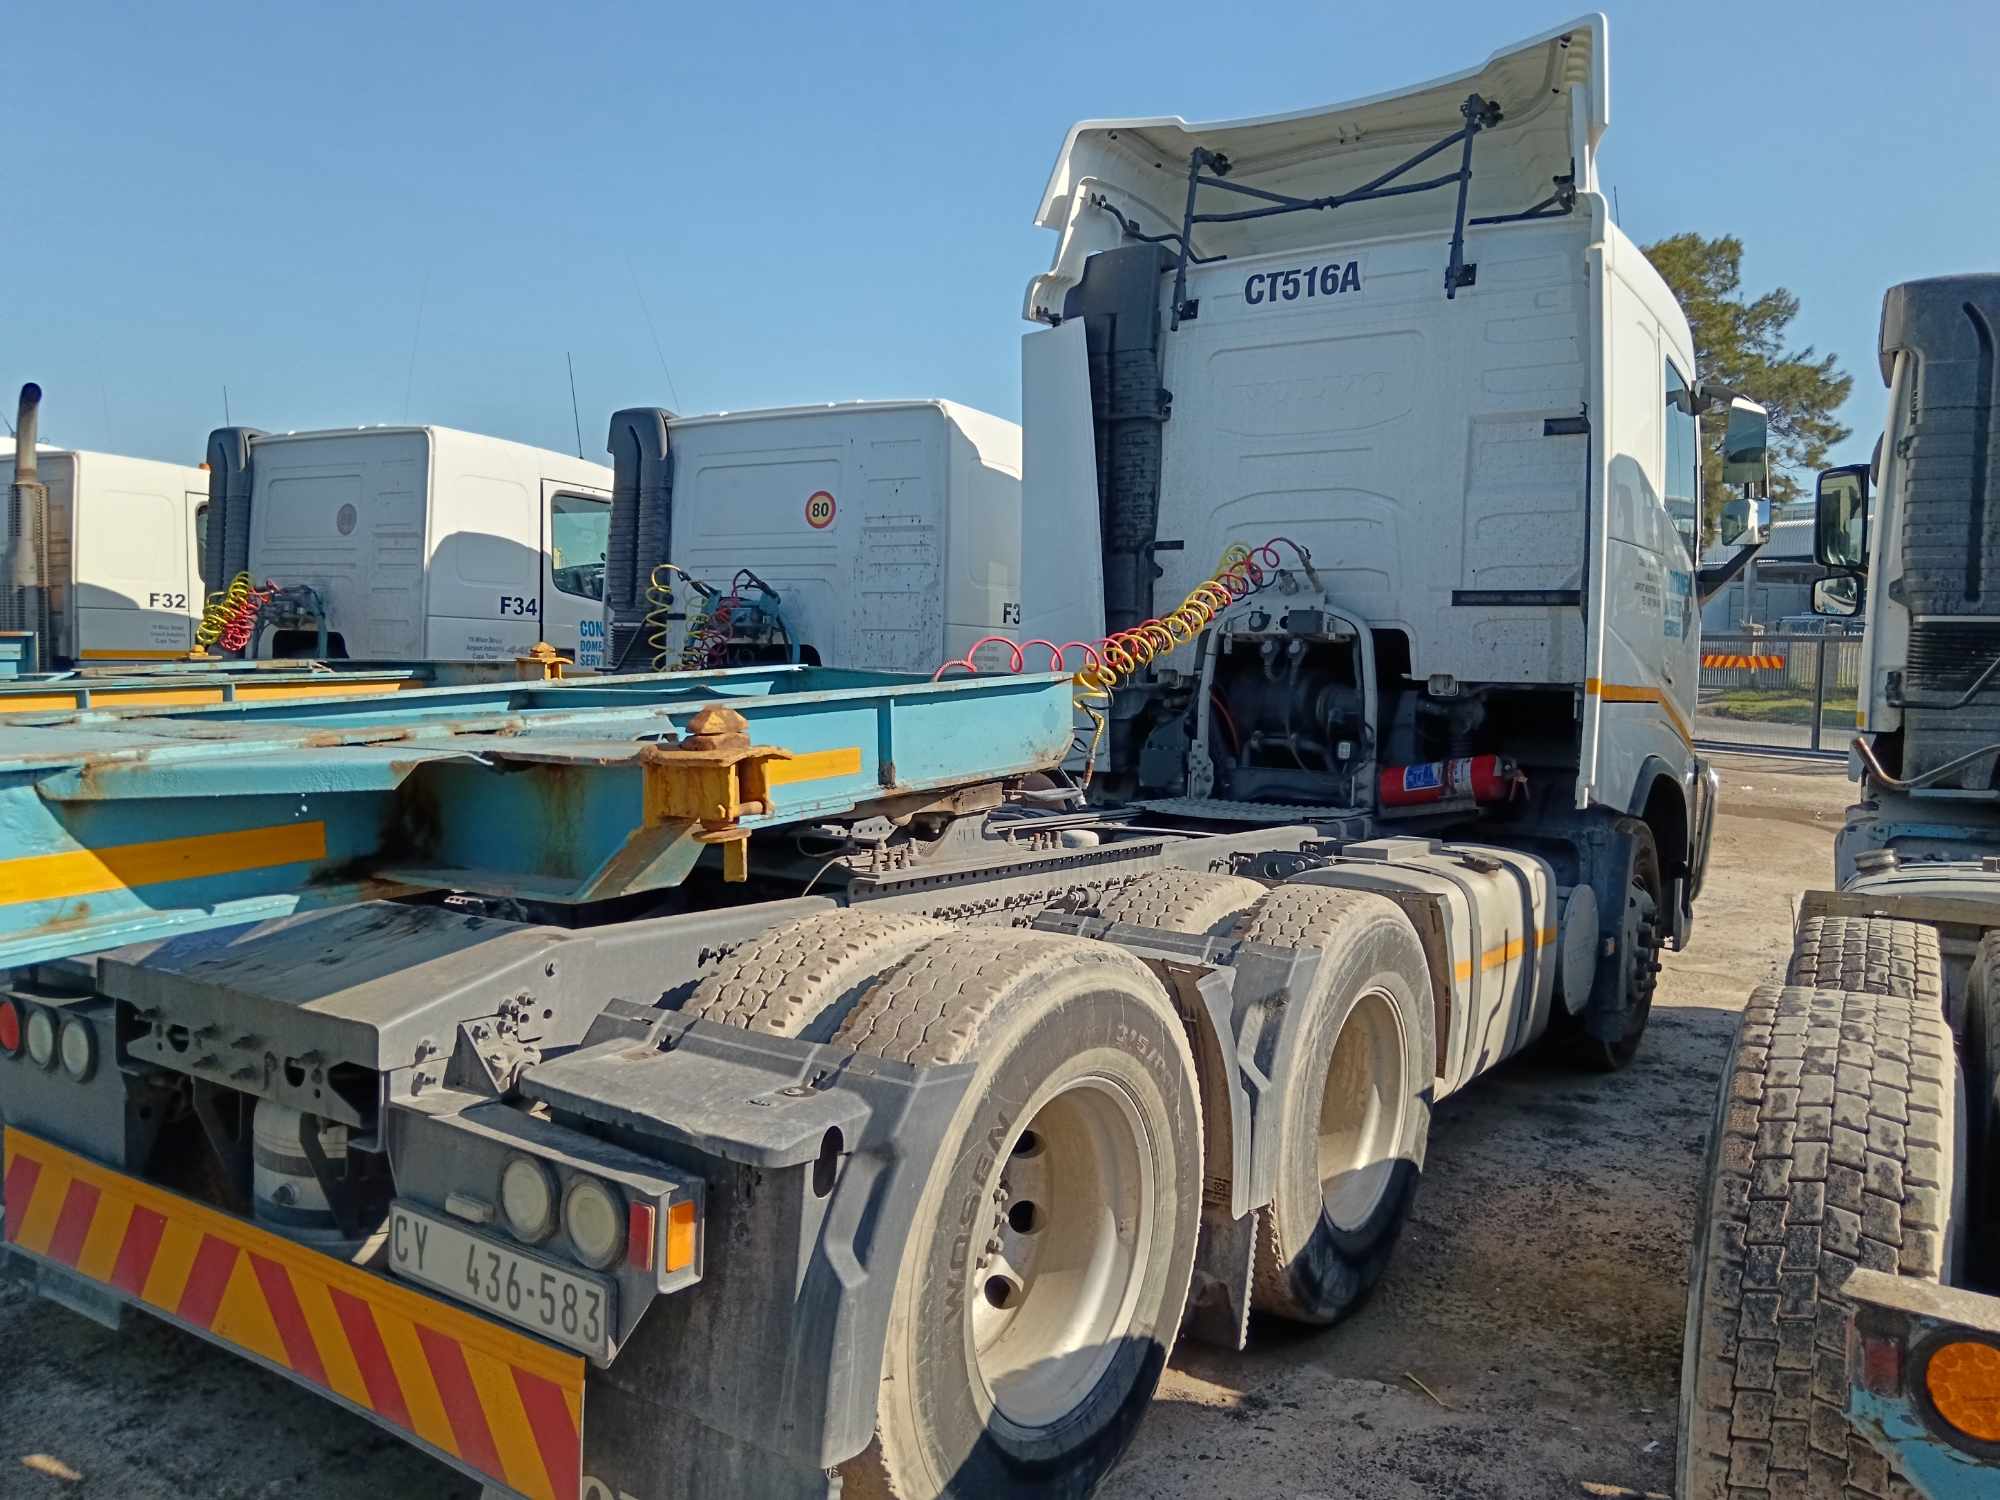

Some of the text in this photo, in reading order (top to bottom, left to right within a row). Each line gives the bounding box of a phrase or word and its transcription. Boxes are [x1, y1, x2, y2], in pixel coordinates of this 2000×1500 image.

[1244, 260, 1361, 305] CT516A
[812, 502, 829, 518] 80
[150, 592, 187, 608] F32
[500, 596, 538, 616] F34
[394, 1214, 601, 1344] CY 436-583
